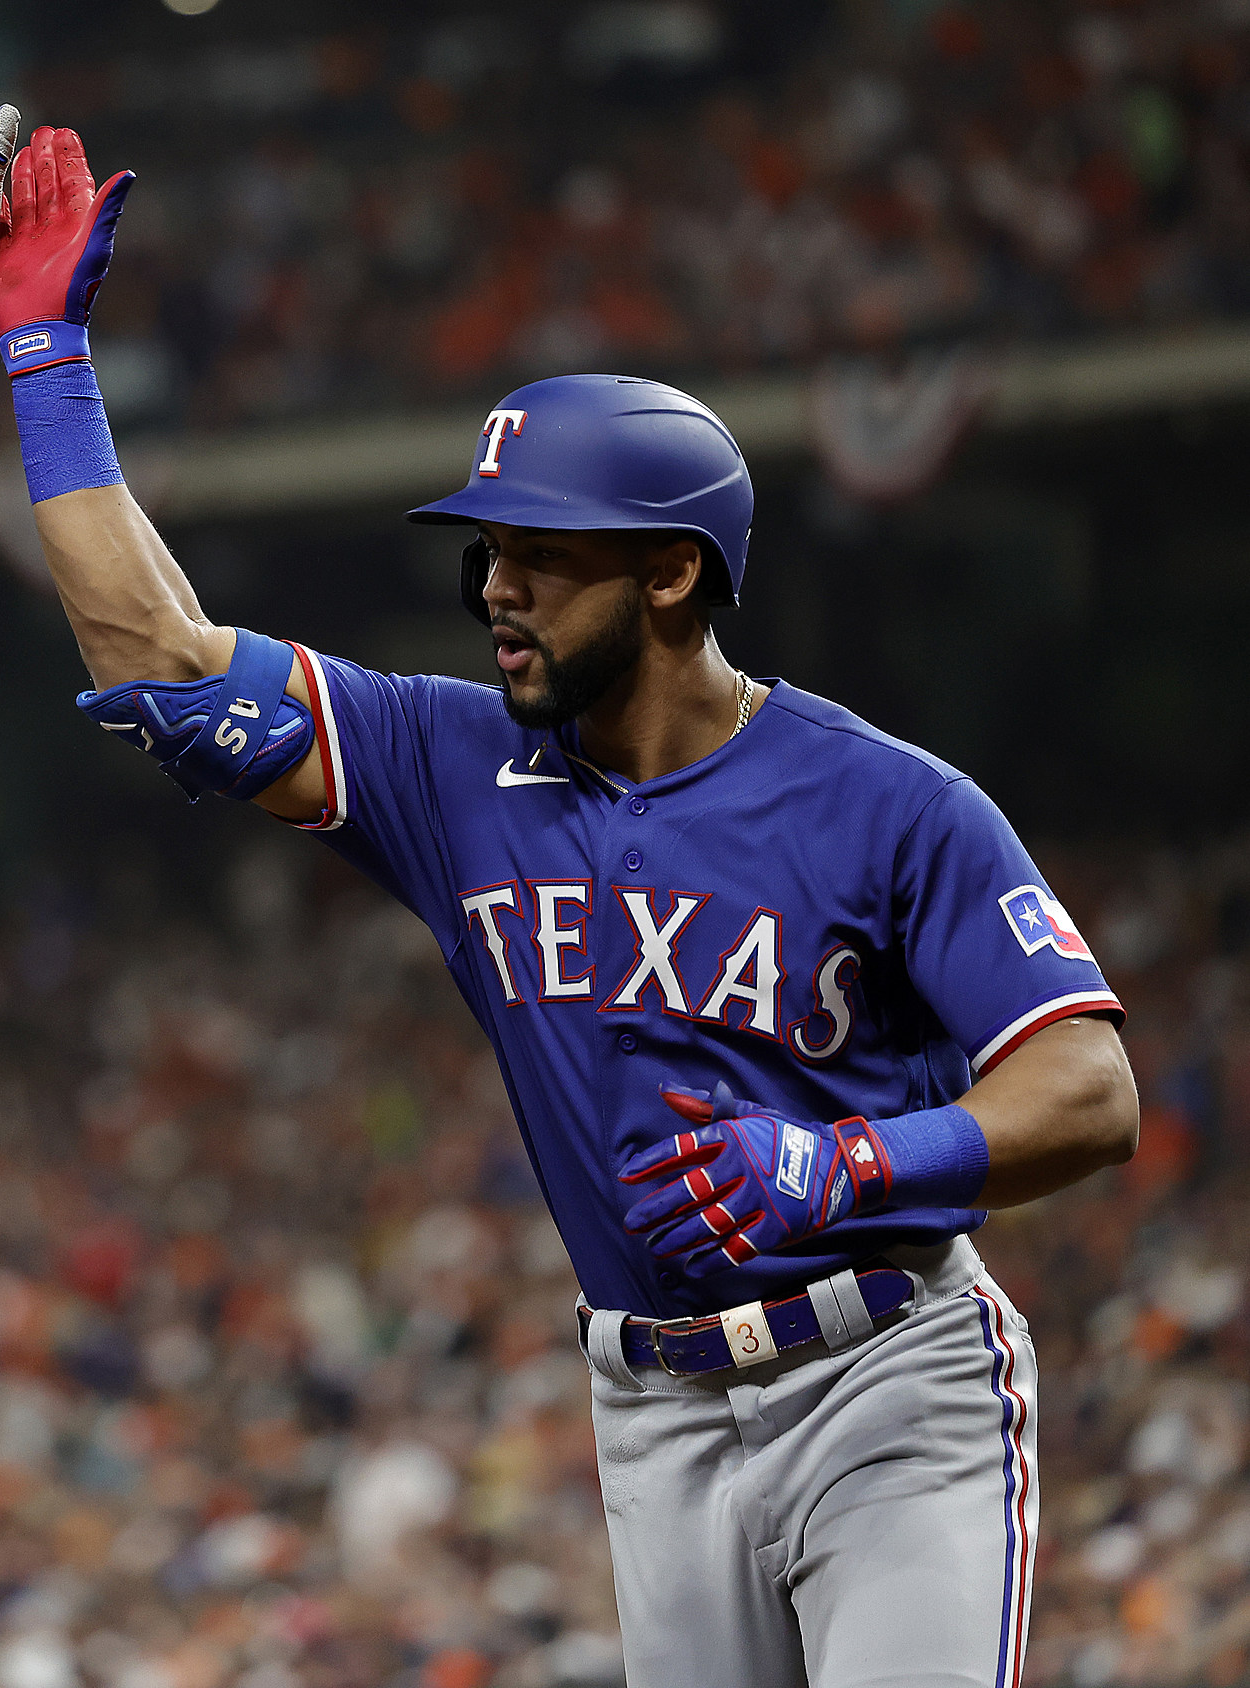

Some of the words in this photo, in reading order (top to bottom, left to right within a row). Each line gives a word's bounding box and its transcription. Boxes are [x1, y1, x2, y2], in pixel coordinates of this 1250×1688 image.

[13, 337, 45, 355] Franklin
[479, 409, 527, 477] T
[458, 878, 861, 1064] TEXAS
[736, 1322, 760, 1354] 3
